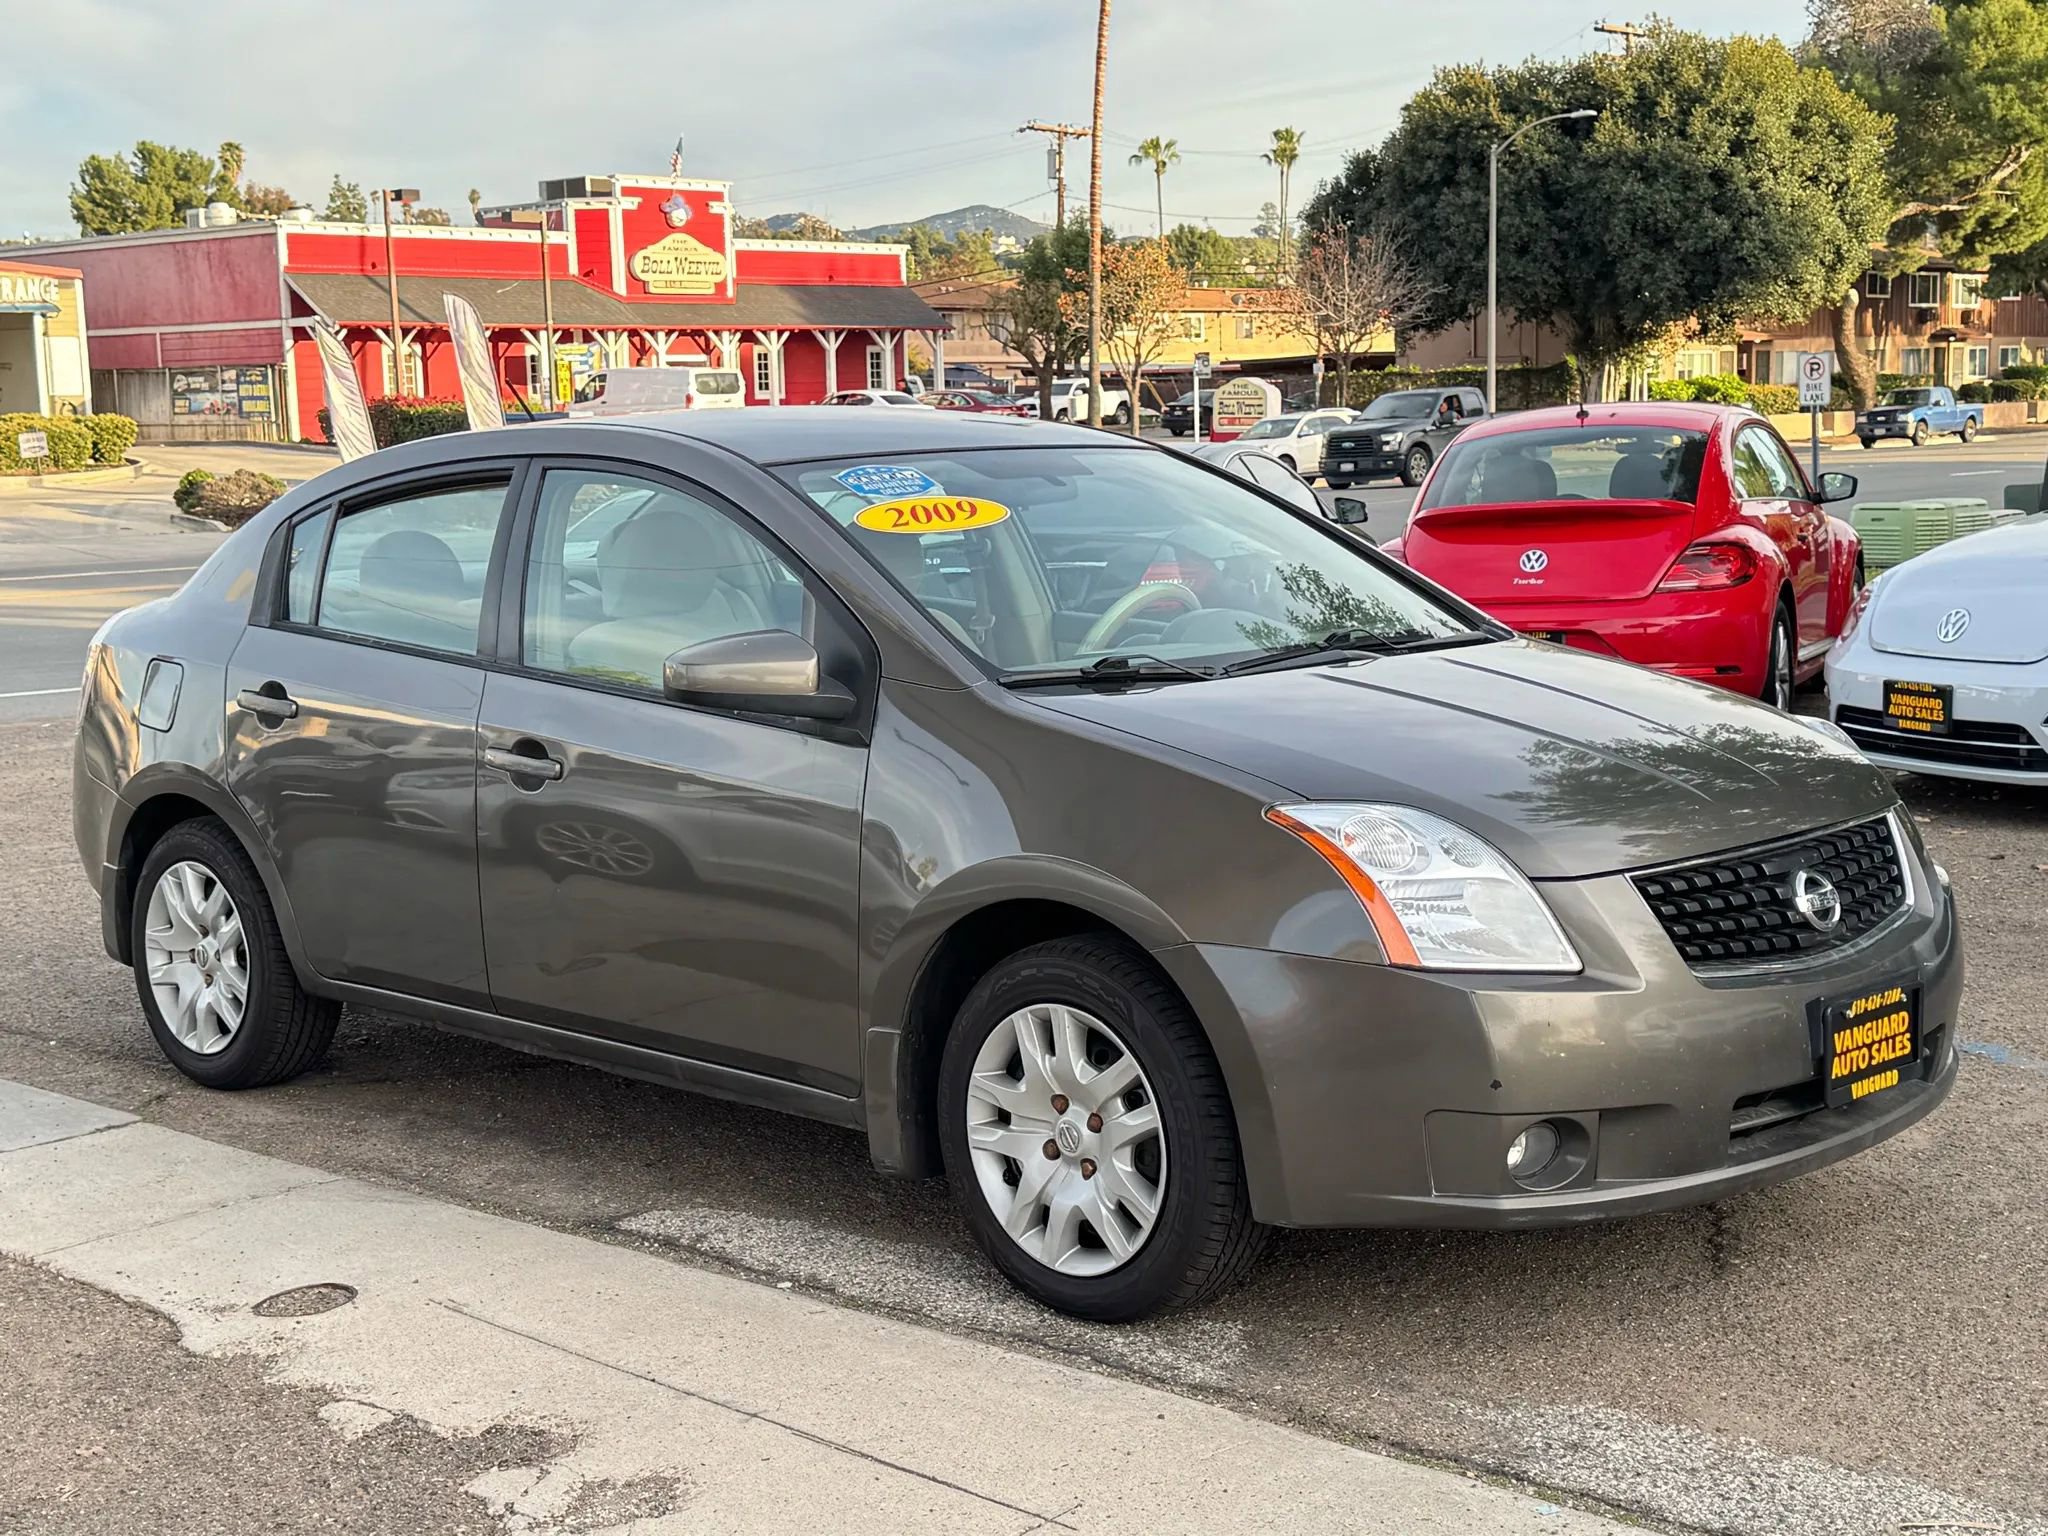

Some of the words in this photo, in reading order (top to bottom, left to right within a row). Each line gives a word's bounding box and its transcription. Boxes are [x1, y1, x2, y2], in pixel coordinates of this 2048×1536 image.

[1804, 393, 1825, 401] LANE
[1805, 383, 1822, 392] BIKE
[885, 500, 978, 529] 2009
[1888, 704, 1913, 717] AUTO
[1915, 707, 1944, 721] SALES
[1890, 693, 1943, 710] VANGUARD
[1834, 1011, 1909, 1054] VANGUARD
[1831, 1047, 1869, 1080] AUTO
[1871, 1033, 1912, 1066] SALES
[1851, 1069, 1899, 1100] VANGUARD
